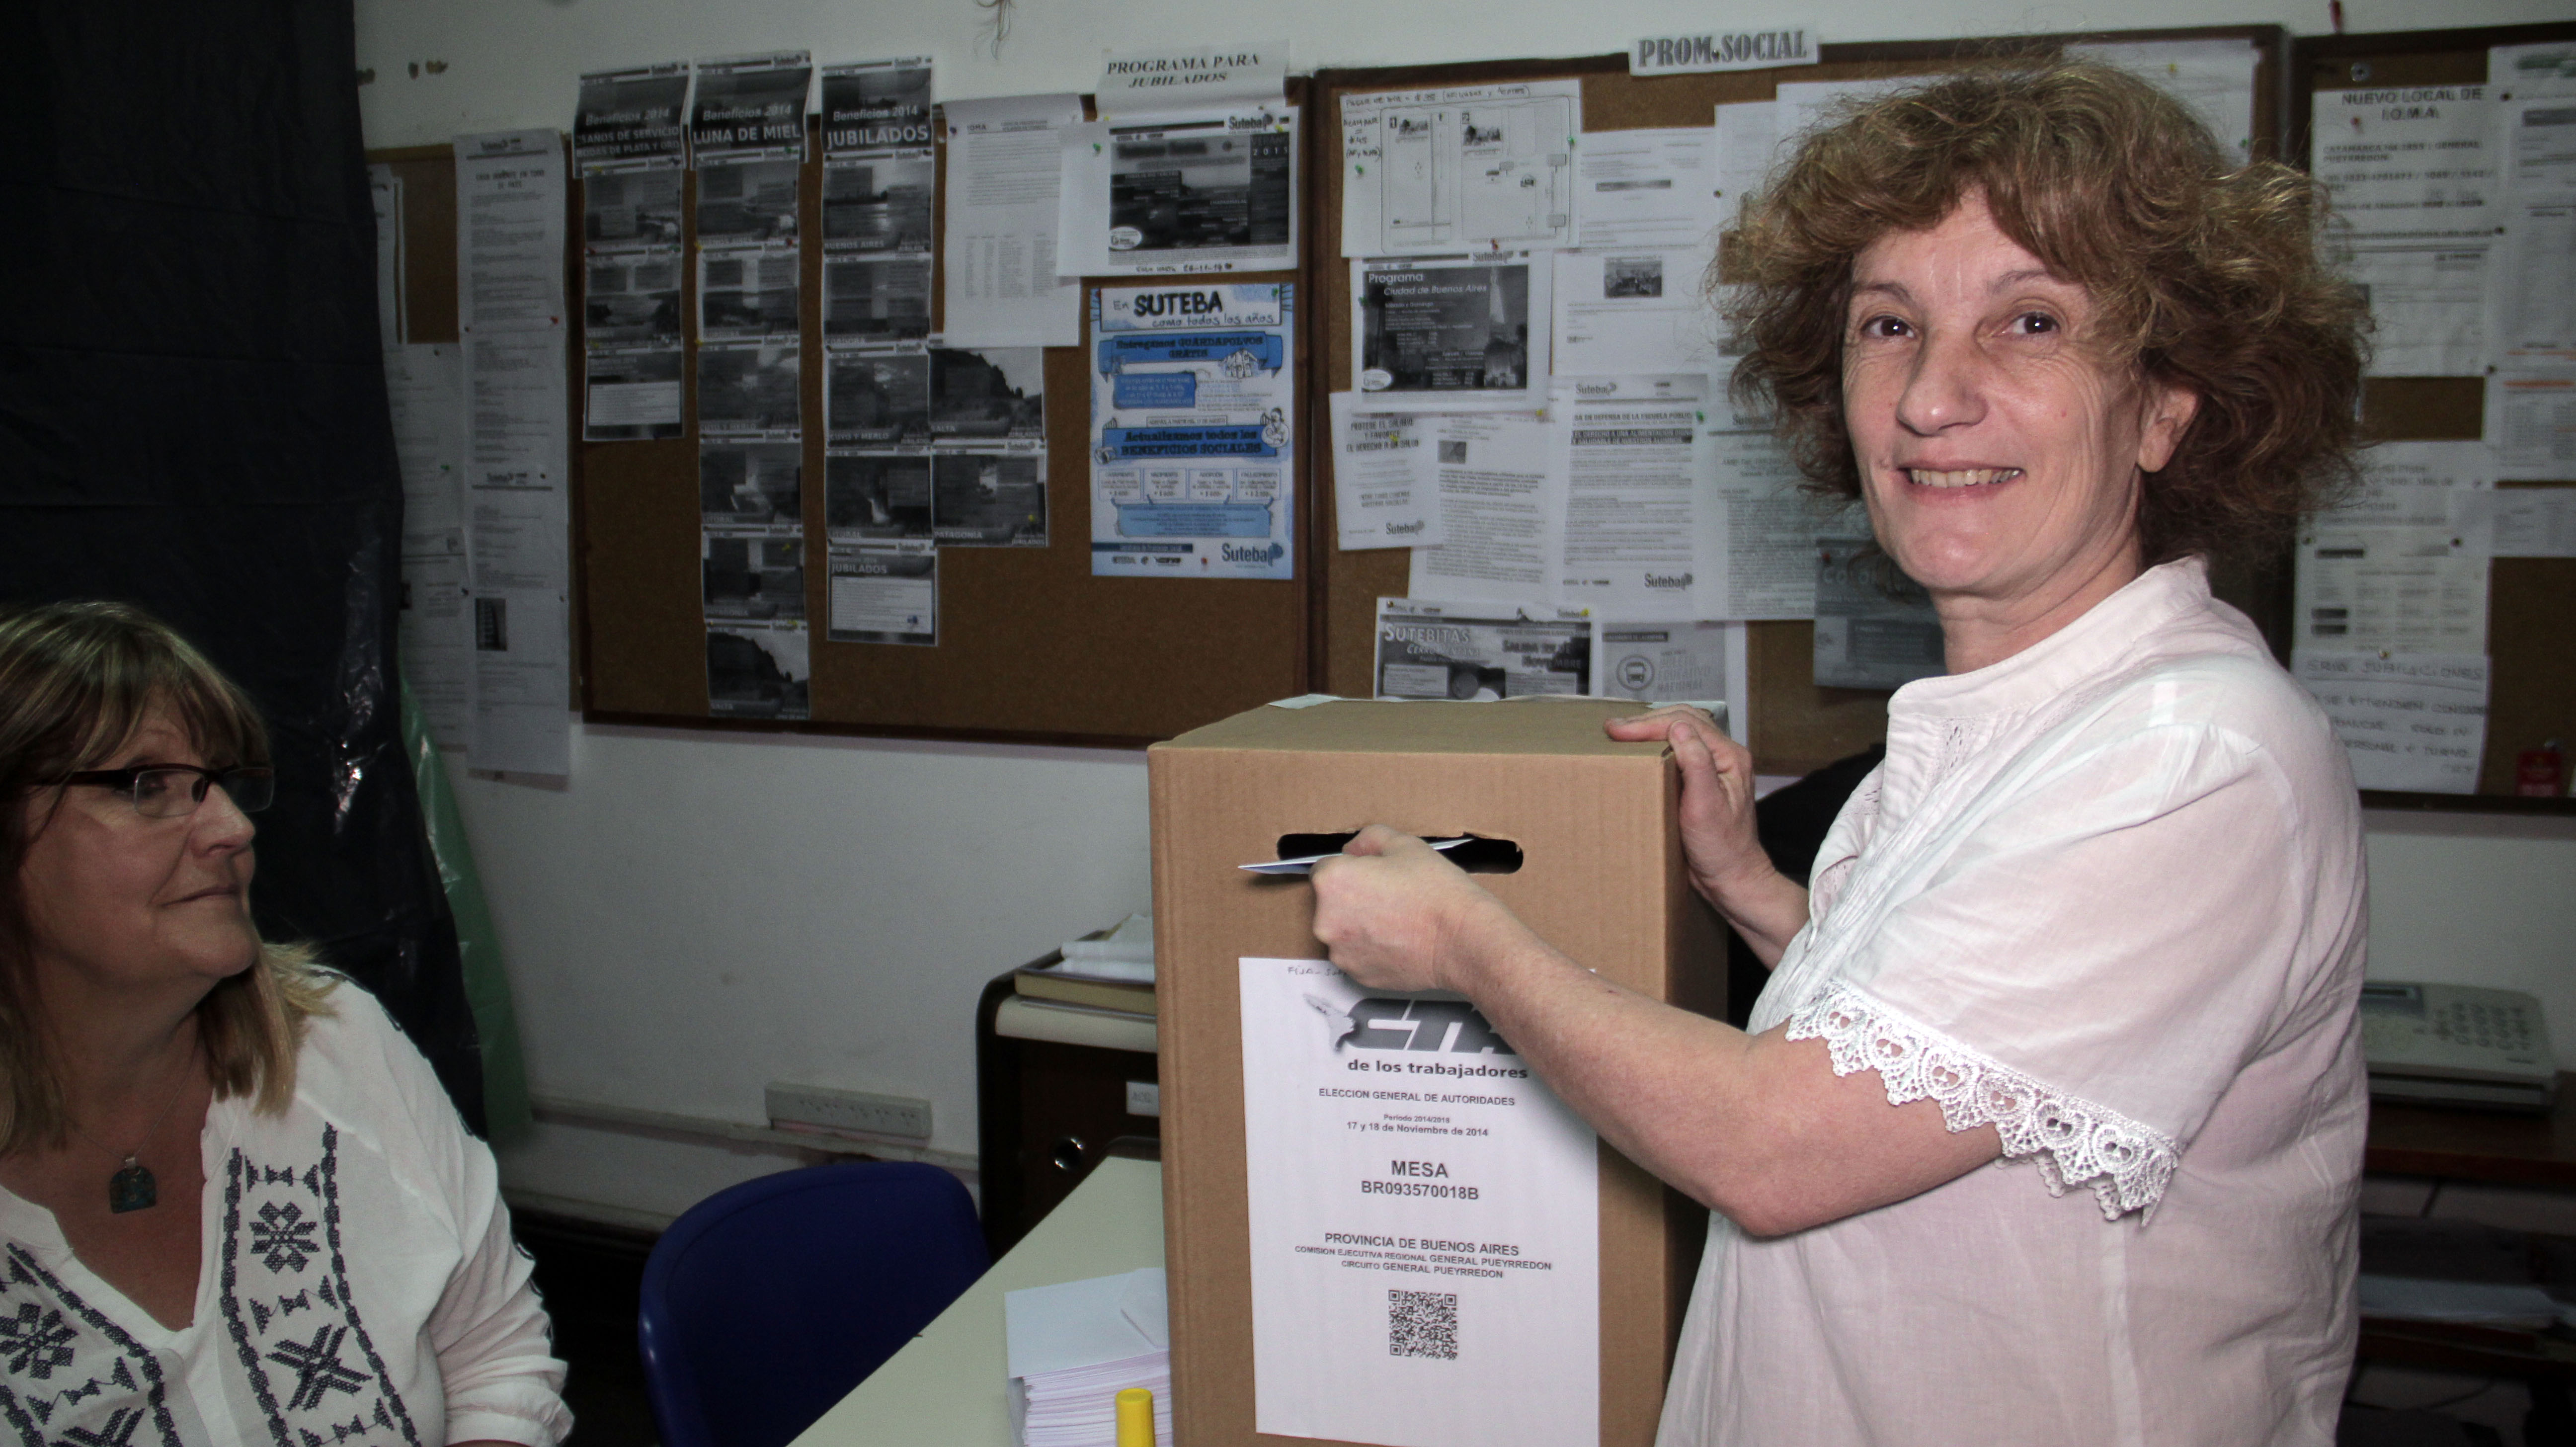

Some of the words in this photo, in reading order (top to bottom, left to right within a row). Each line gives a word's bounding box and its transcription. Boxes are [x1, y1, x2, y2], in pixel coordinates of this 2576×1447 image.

[1107, 57, 1206, 75] PROGRAMA
[1213, 53, 1259, 68] PARA
[1128, 73, 1228, 88] JUBILADOS
[2342, 92, 2397, 105] NUEVO
[2402, 90, 2455, 102] LOCAL
[2461, 88, 2482, 101] DE
[585, 112, 642, 126] Beneficios
[644, 108, 669, 121] 2014
[702, 107, 761, 122] Beneficios
[764, 104, 792, 117] 2014
[833, 108, 888, 122] Beneficios
[892, 105, 918, 117] 2014
[1229, 116, 1264, 130] Suteba
[617, 130, 631, 140] DE
[633, 126, 679, 139] SERVICIO
[693, 127, 733, 145] LUNA
[737, 126, 758, 141] DE
[763, 124, 801, 140] MIEL
[826, 125, 928, 150] JUBILADOS
[623, 142, 650, 154] PLATA
[1368, 273, 1424, 285] Programa
[1384, 286, 1416, 296] Ciudad
[1418, 286, 1429, 294] de
[1432, 285, 1463, 294] Buenos
[1113, 299, 1128, 311] En
[1133, 291, 1223, 317] SUTEBA
[1152, 317, 1183, 328] como
[1187, 314, 1220, 326] todos
[1224, 313, 1241, 324] los
[1245, 312, 1274, 323] años
[1576, 383, 1607, 395] Suteba
[1126, 431, 1203, 443] Actualizamos
[1206, 429, 1238, 441] todos
[1240, 428, 1257, 440] los
[1121, 443, 1198, 456] BENEFICIOS
[1200, 442, 1262, 454] SOCIALES
[1386, 522, 1415, 535] Suteba
[1222, 543, 1268, 563] Suteba
[831, 563, 887, 574] JUBILADOS
[1645, 573, 1681, 588] Suteba
[1385, 623, 1470, 643] SUTEBITAS
[1348, 1059, 1369, 1071] de
[1376, 1060, 1401, 1073] los
[1409, 1063, 1528, 1079] trabajadores
[1319, 1088, 1369, 1099] ELECCION
[1372, 1091, 1421, 1102] GENERAL
[1424, 1093, 1438, 1102] DE
[1441, 1095, 1515, 1106] AUTORIDADES
[1414, 1116, 1450, 1124] 2014/2018
[1347, 1122, 1357, 1130] 17
[1360, 1124, 1366, 1132] y
[1368, 1123, 1379, 1131] 18
[1382, 1124, 1394, 1132] de
[1397, 1124, 1448, 1135] Noviembre
[1451, 1127, 1462, 1136] de
[1466, 1128, 1488, 1137] 2014
[1391, 1160, 1449, 1178] MESA
[1362, 1181, 1479, 1200] BR093570018B
[1325, 1233, 1395, 1248] PROVINCIA
[1399, 1238, 1417, 1249] DE
[1421, 1239, 1475, 1253] BUENOS
[1480, 1244, 1519, 1256] AIRES
[1295, 1246, 1335, 1255] COMISION
[1338, 1249, 1382, 1259] EJECUTIVA
[1384, 1252, 1426, 1262] REGIONAL
[1430, 1254, 1478, 1266] GENERAL
[1481, 1258, 1552, 1271] PUEYRREDON
[1341, 1260, 1380, 1270] CIRCUITO
[1382, 1262, 1430, 1274] GENERAL
[1434, 1267, 1503, 1279] PUEYRREDON
